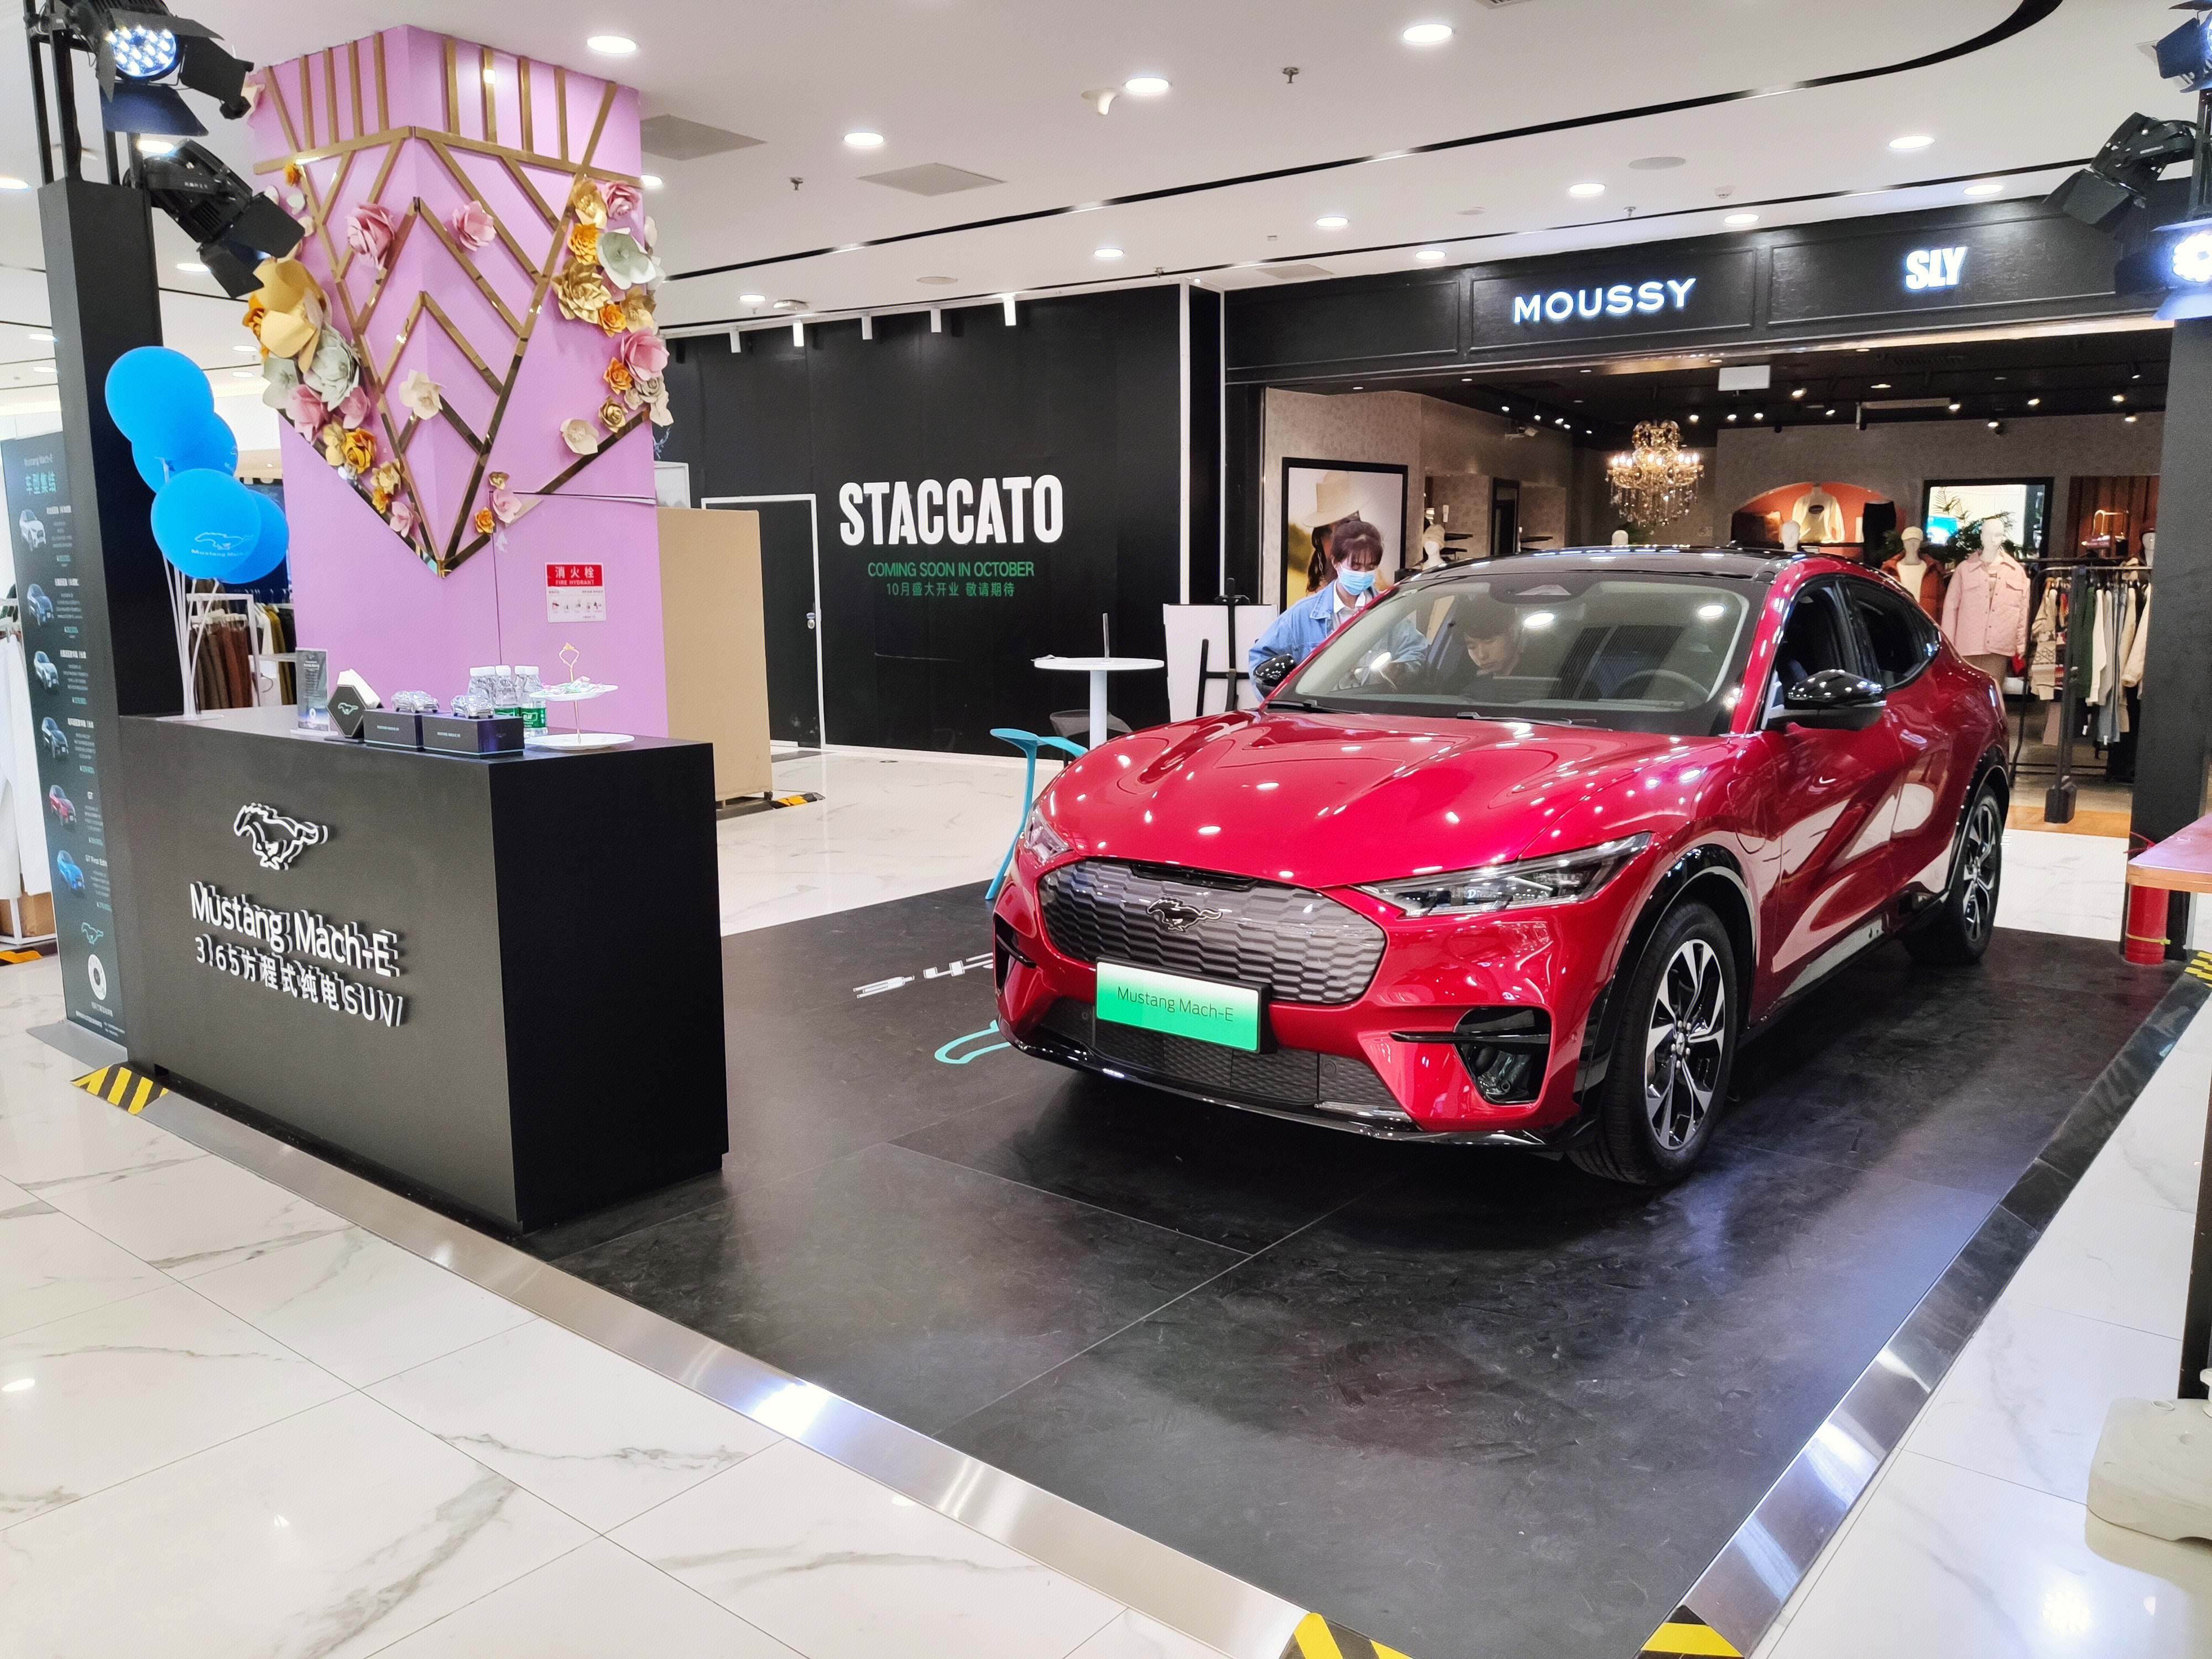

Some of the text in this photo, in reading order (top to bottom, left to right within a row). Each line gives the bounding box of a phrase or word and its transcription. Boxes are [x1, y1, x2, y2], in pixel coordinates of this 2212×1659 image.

[1905, 246, 1967, 290] SLY
[1513, 278, 1697, 323] MOUSSY
[839, 474, 1063, 546] STACCATO
[555, 566, 594, 578] 消火栓
[868, 561, 1035, 577] COMING SOON IN OCTOBER
[886, 582, 1015, 597] 10月盛大开业 敬请期待
[190, 881, 400, 977] Mustang Mach-E
[1118, 986, 1234, 1022] Mustang Mach-E
